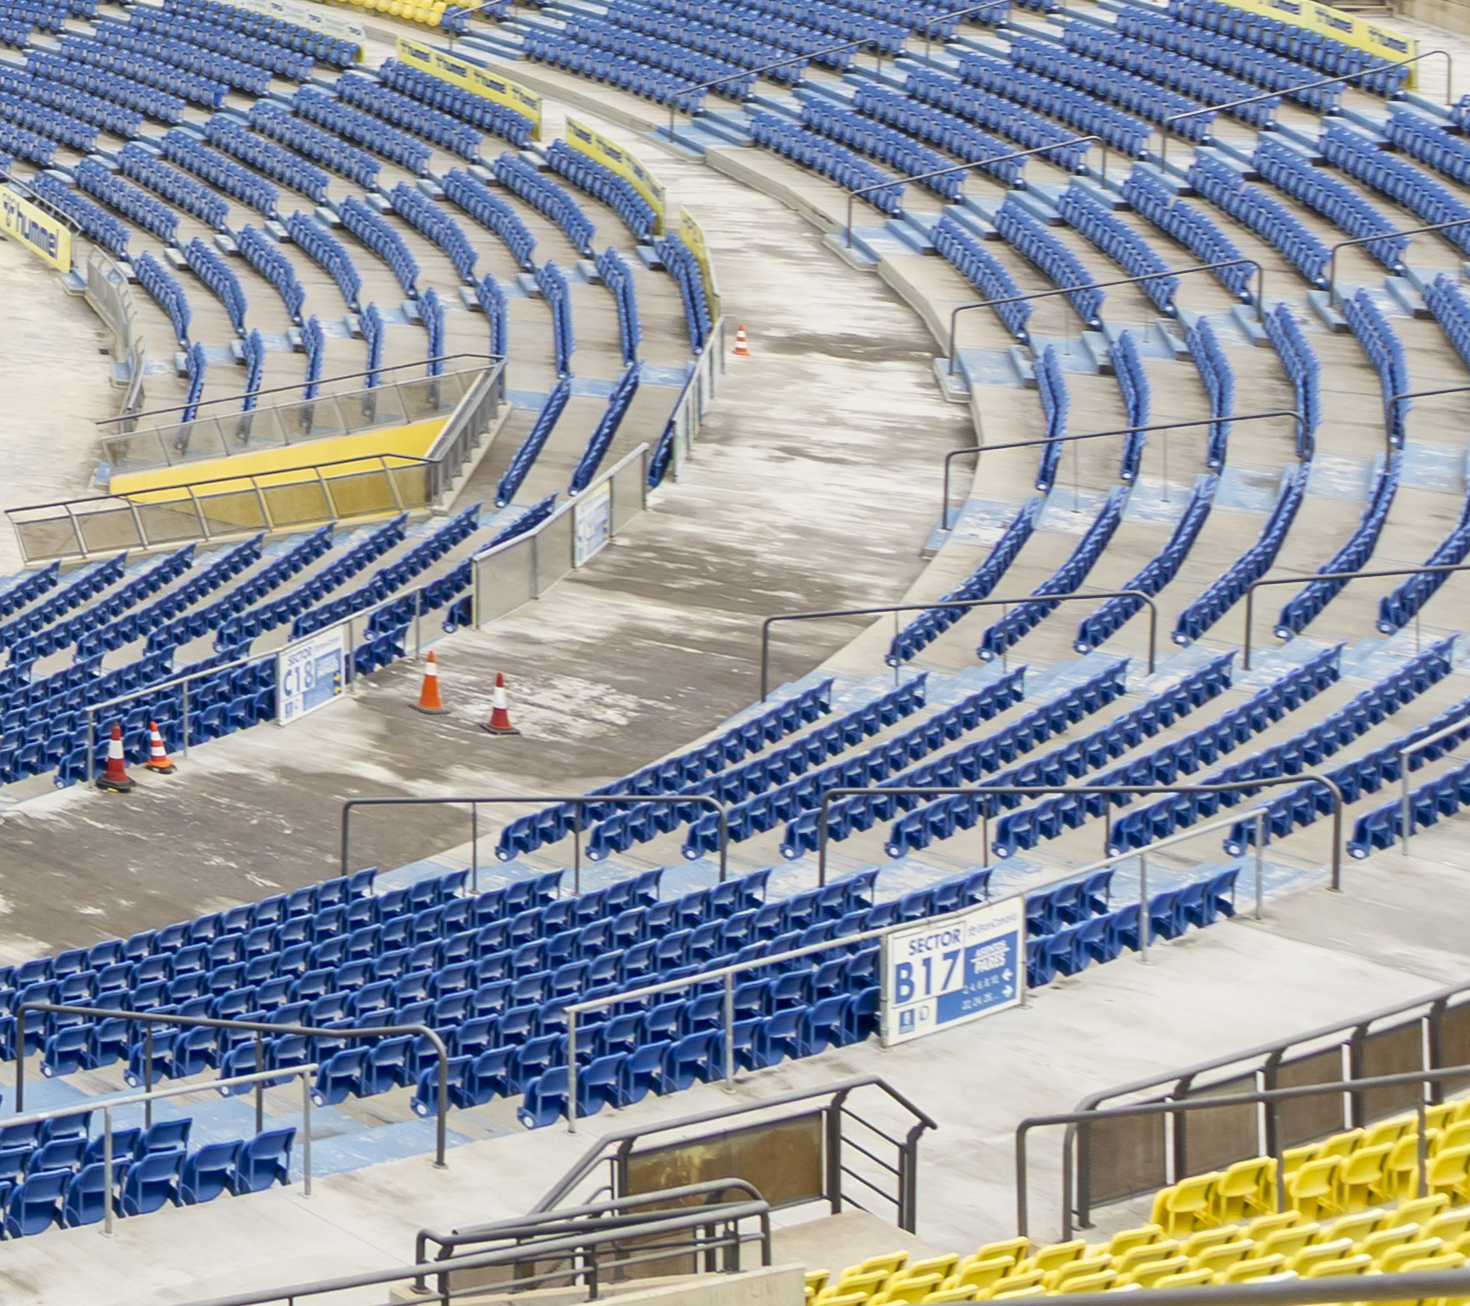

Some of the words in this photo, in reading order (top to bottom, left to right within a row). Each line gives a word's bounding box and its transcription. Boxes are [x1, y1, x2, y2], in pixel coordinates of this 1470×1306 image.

[16, 201, 60, 260] hummel
[283, 660, 313, 697] C18
[909, 928, 961, 956] SECTOR
[895, 949, 962, 1005] B17
